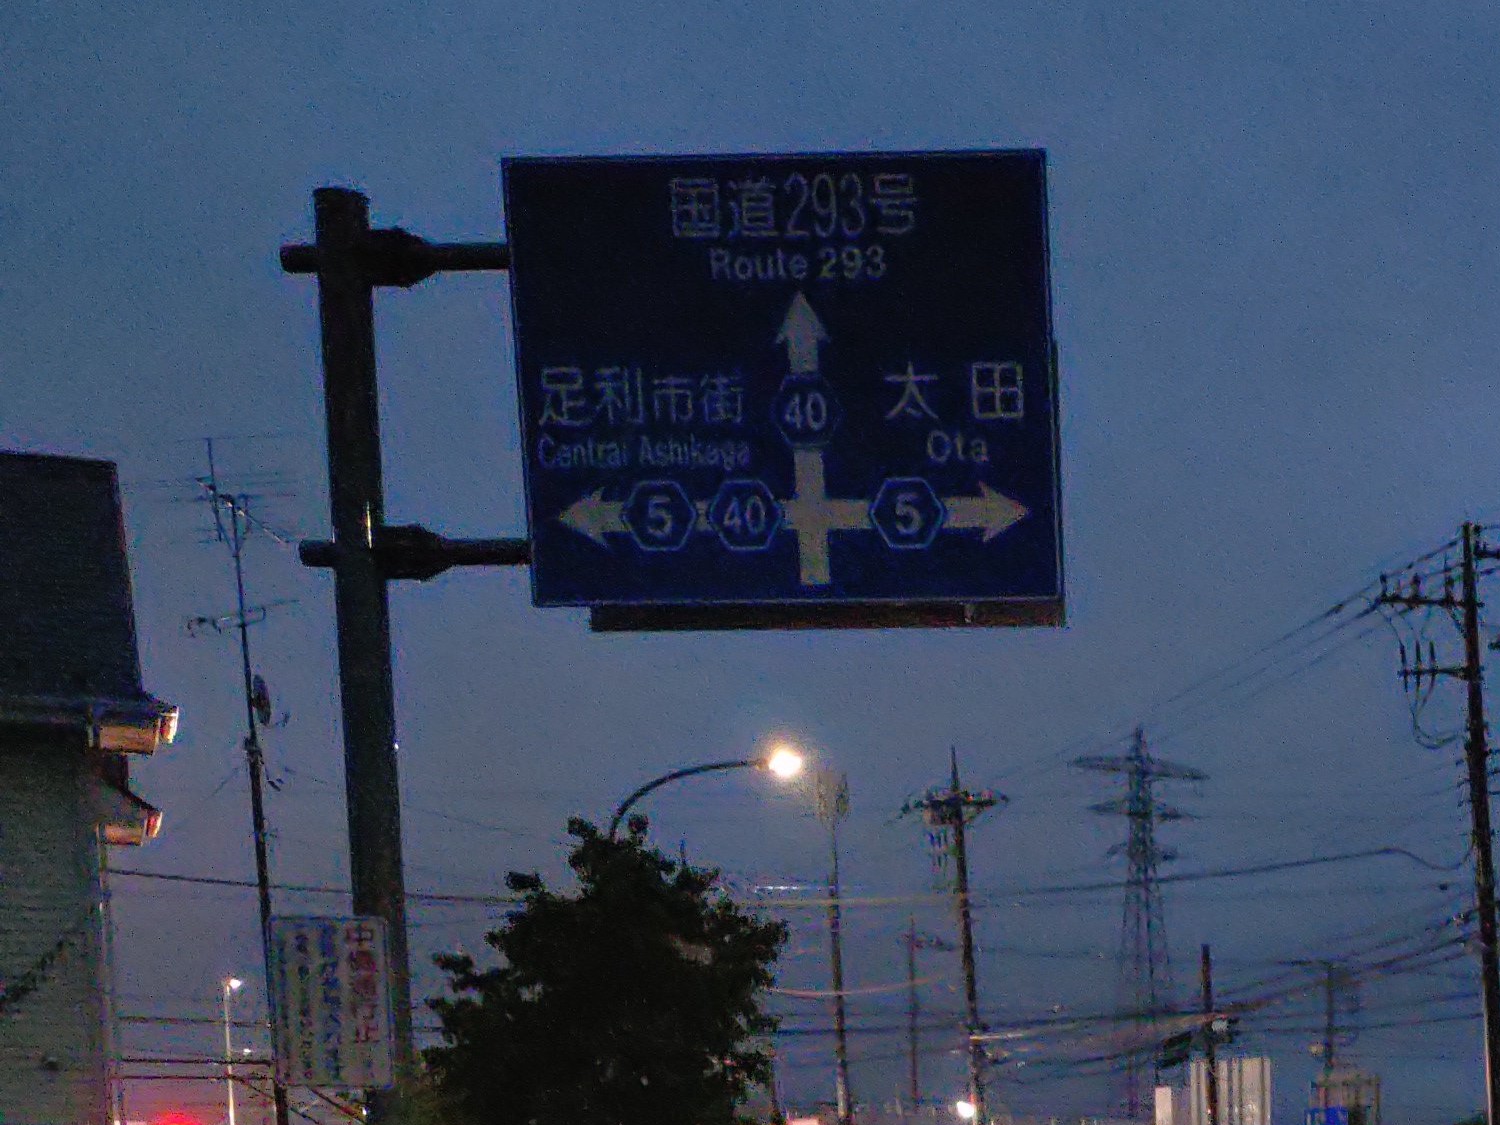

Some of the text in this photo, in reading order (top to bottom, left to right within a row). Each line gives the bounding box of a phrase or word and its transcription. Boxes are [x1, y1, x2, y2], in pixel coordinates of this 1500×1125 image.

[670, 174, 918, 240] 国道293号
[711, 246, 887, 281] Route 293
[538, 366, 744, 426] 足利市街
[784, 393, 828, 431] 40
[884, 361, 1024, 423] 太田
[537, 434, 751, 471] Central Ashikaga
[927, 432, 989, 464] Ota
[647, 495, 673, 537] 5
[722, 495, 767, 535] 40
[895, 494, 922, 535] 5
